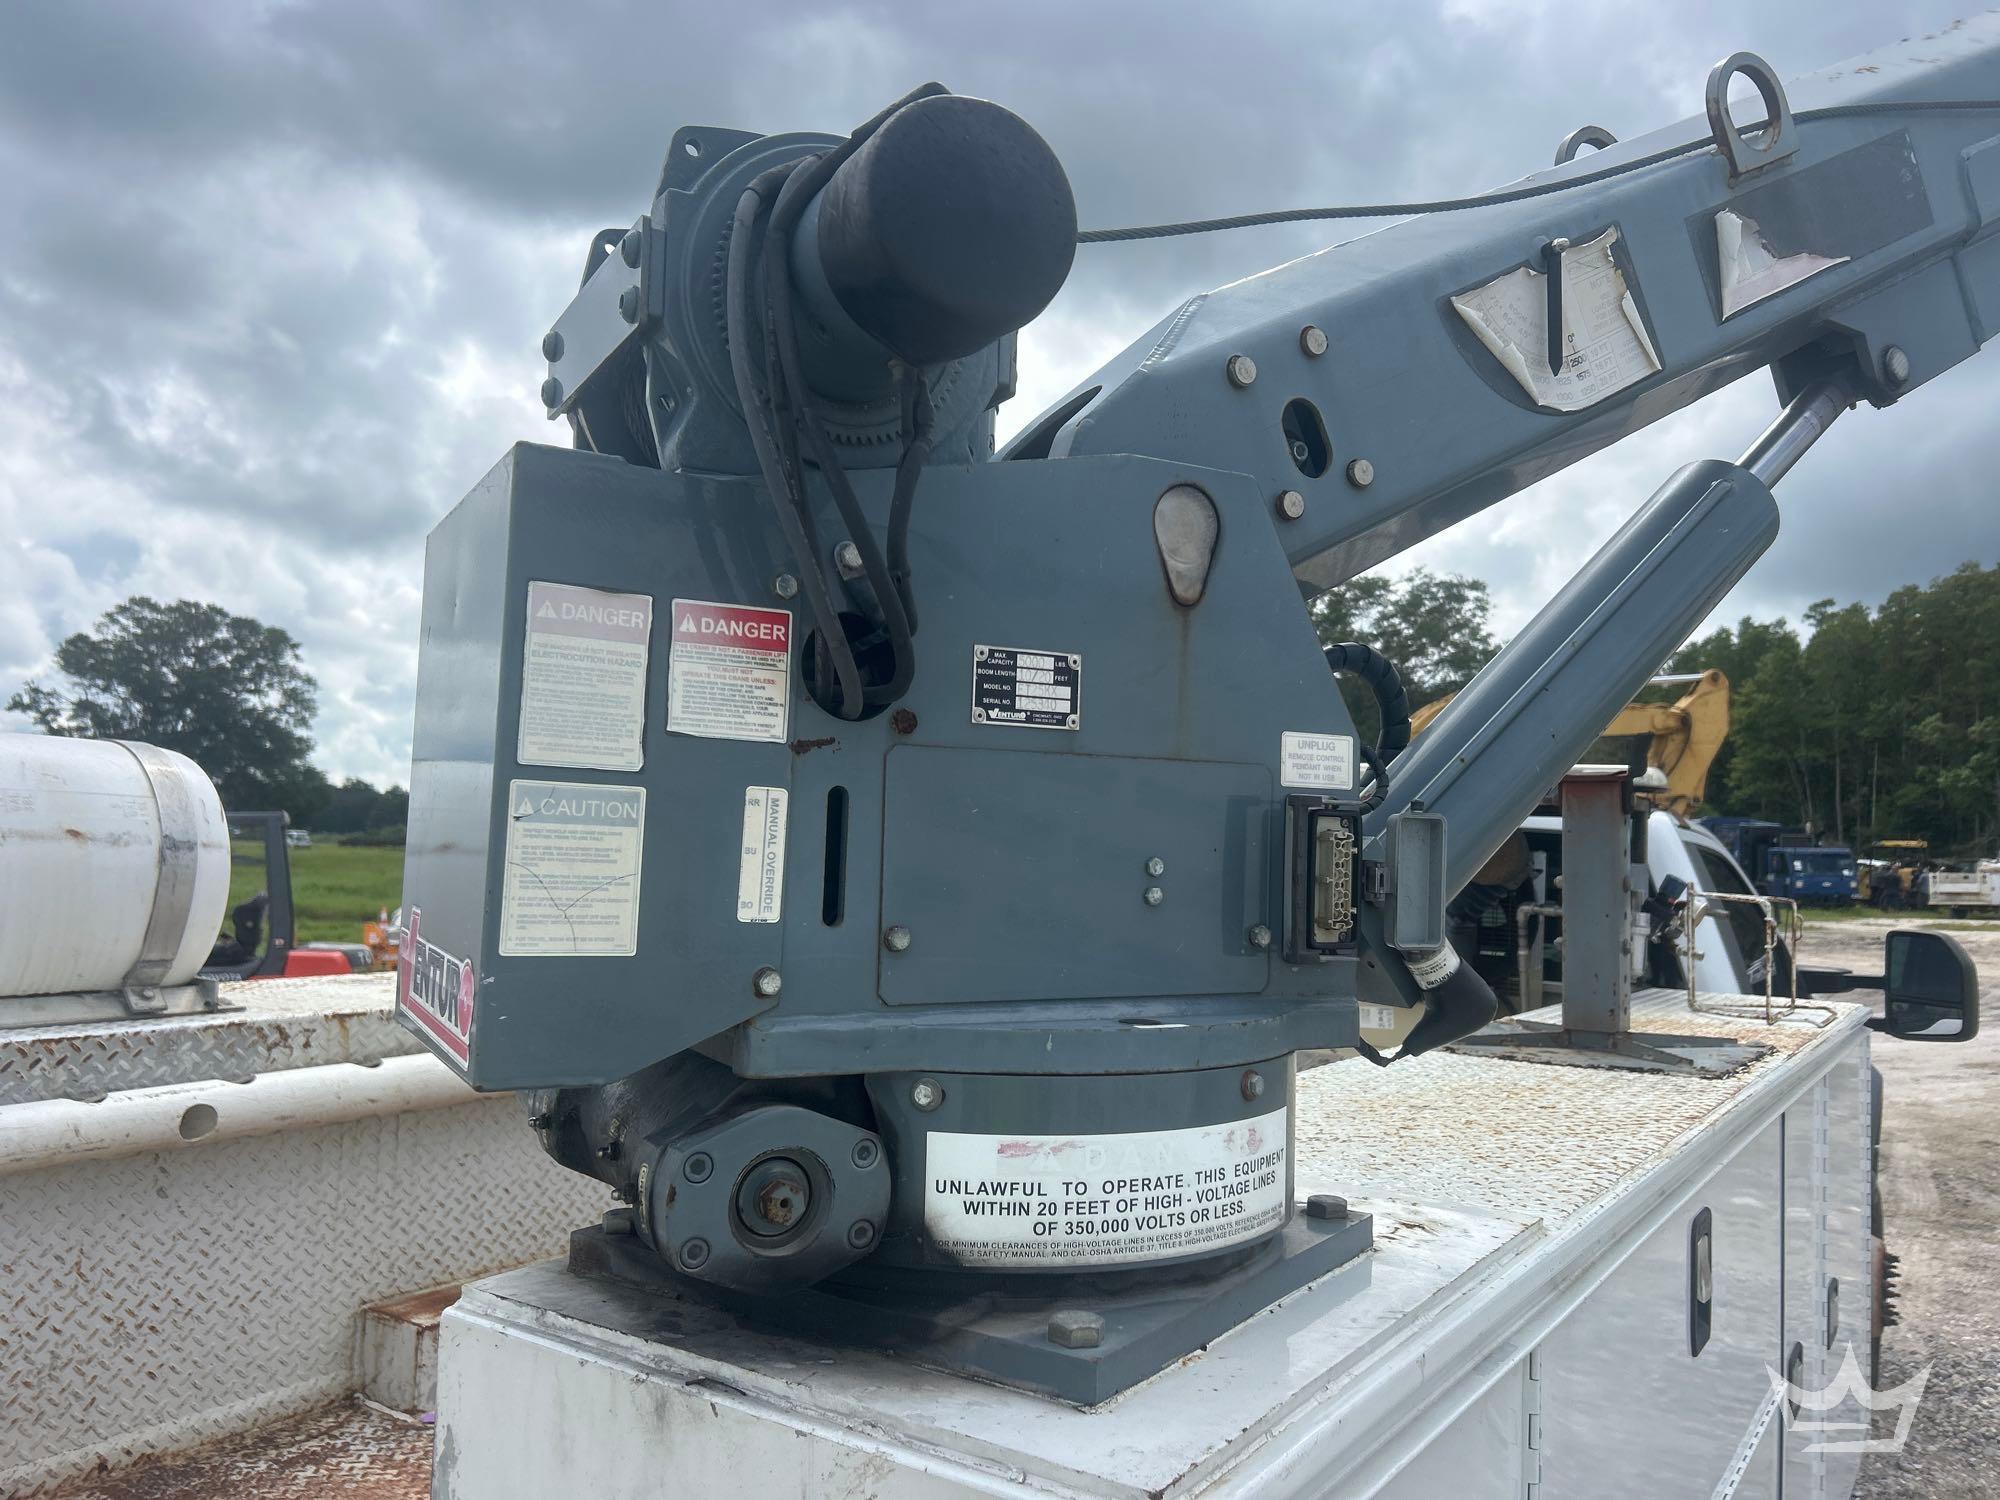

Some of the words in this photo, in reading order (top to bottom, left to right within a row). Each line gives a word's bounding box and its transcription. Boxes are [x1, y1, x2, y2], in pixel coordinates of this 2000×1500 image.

[1569, 352, 1588, 368] 2500
[561, 602, 645, 629] DANGER
[701, 617, 786, 641] DANGER
[987, 658, 1014, 666] CAPACITY
[982, 697, 1001, 705] SERIAL
[988, 708, 1026, 721] VENTURO
[1287, 752, 1315, 760] REMOTE
[1297, 740, 1336, 751] UNPLUG
[540, 798, 638, 820] CAUTION
[747, 798, 760, 806] RR
[767, 797, 780, 849] MANUAL
[762, 851, 776, 913] OVERRIDE
[400, 904, 475, 1040] VENTURO
[935, 1179, 1048, 1197] UNLAWFUL
[1062, 1181, 1088, 1196] TO
[1102, 1173, 1184, 1195] OPERATE
[1194, 1167, 1226, 1186] THIS
[1234, 1147, 1285, 1178] EQUIPMENT
[963, 1200, 1030, 1216] WITHIN
[1037, 1202, 1058, 1216] 20
[1064, 1200, 1110, 1216] FEET
[1116, 1197, 1138, 1214] OF
[1144, 1193, 1182, 1211] HIGH
[1196, 1181, 1250, 1204] VOLTAGE
[1252, 1170, 1276, 1192] LINES
[1032, 1221, 1058, 1236] OF
[1064, 1218, 1129, 1237] 350,000
[1135, 1211, 1185, 1231] VOLTS
[1190, 1207, 1210, 1224] OR
[1214, 1200, 1246, 1220] LESS.
[952, 1240, 989, 1249] MINIMUM
[991, 1241, 1048, 1250] CLEARANCES
[1064, 1238, 1122, 1249] HIGH-VOLTAGE
[1123, 1237, 1145, 1246] LINES
[1155, 1232, 1182, 1242] EXCESS
[1183, 1230, 1192, 1238] OF
[977, 1250, 1009, 1258] SAFETY
[1051, 1250, 1069, 1258] AND
[1070, 1247, 1112, 1257] CAL-OSHA
[1113, 1245, 1145, 1255] ARTICLE
[1159, 1241, 1178, 1250] TITLE
